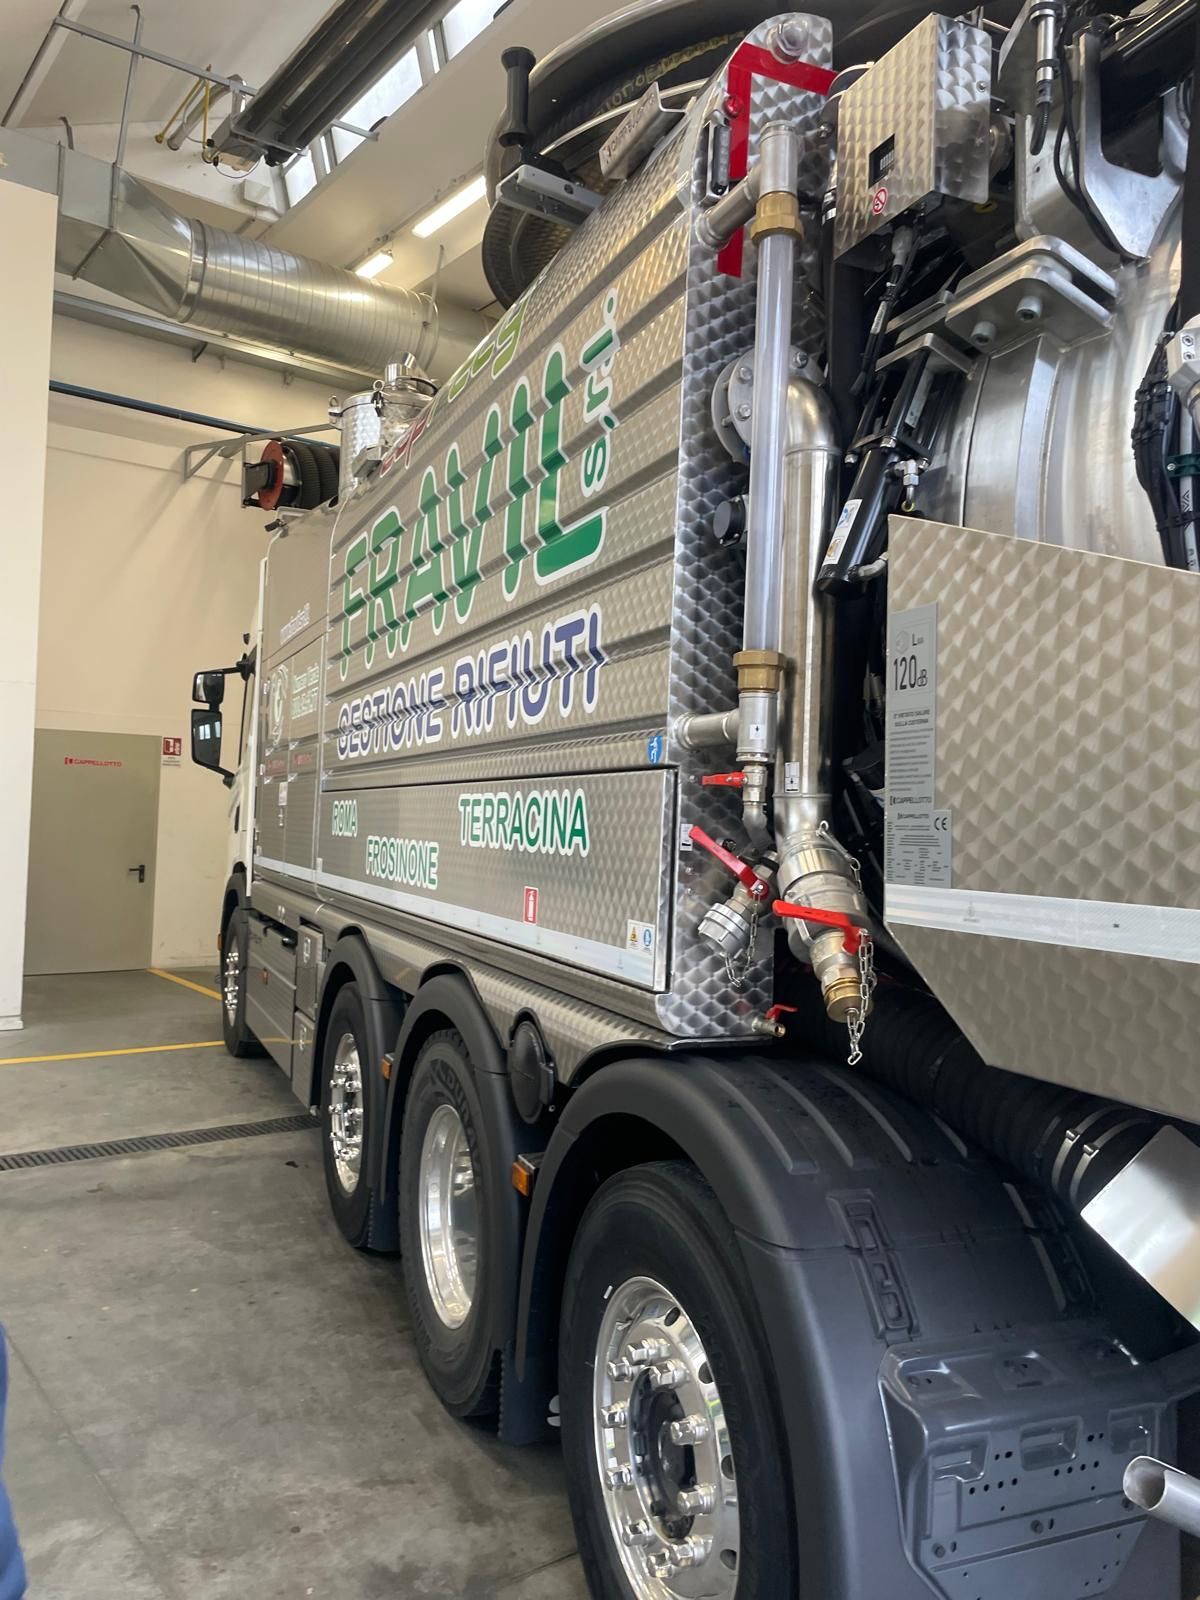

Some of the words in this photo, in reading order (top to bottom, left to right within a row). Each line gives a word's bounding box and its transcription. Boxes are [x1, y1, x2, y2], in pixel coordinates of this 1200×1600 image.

[339, 342, 608, 682] FRAVIL
[337, 667, 447, 760] GESTIONE
[451, 603, 605, 739] RIFIUTI
[331, 800, 358, 837] ROMA
[458, 788, 590, 858] TERRACINA
[365, 835, 439, 889] FROSINONE
